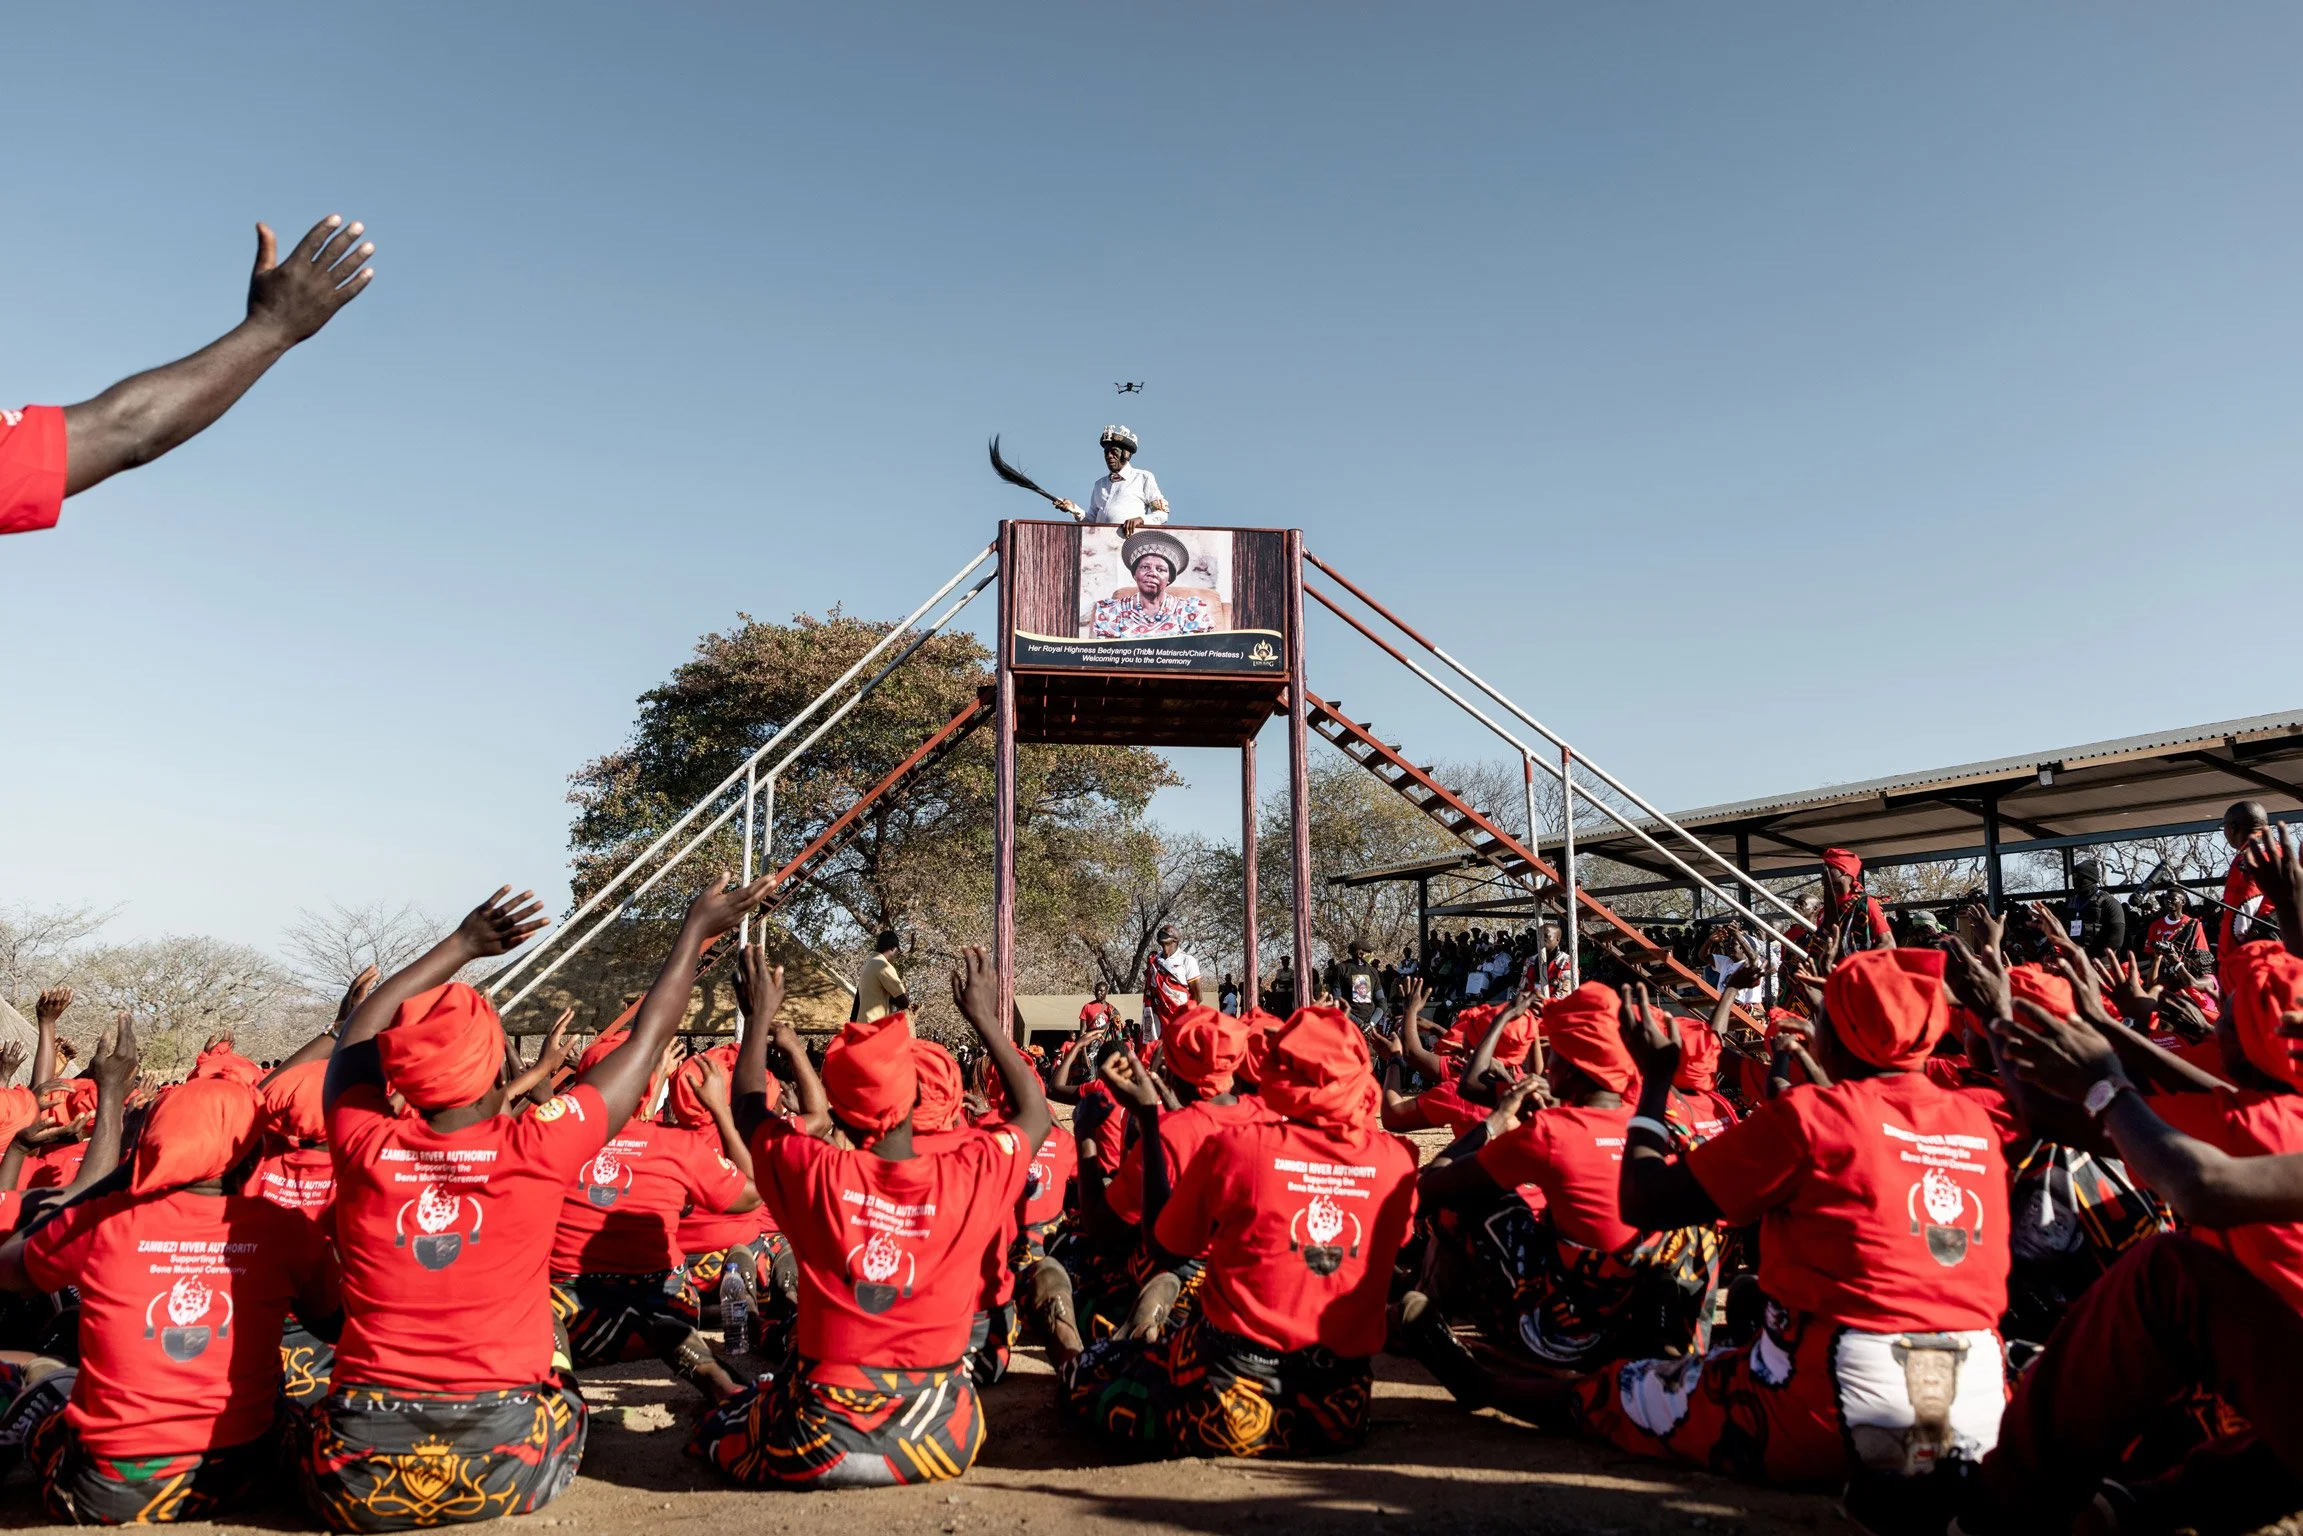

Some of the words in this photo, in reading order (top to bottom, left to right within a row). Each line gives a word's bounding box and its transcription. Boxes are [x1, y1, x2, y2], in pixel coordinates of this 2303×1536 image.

[1043, 645, 1062, 653] Royal
[1064, 646, 1096, 654] Highness
[1098, 647, 1131, 655] Bedyango
[1156, 648, 1207, 657] Matriarch/Chief
[1082, 655, 1120, 664] Welcoming
[1156, 657, 1191, 666] Ceremony
[381, 1148, 418, 1161] ZAMBEZI
[420, 1150, 444, 1161] RIVER
[447, 1150, 498, 1162] AUTHORITY
[414, 1162, 456, 1172] Supporting
[458, 1164, 471, 1172] the
[448, 1174, 489, 1183] Ceremony
[138, 1241, 177, 1253] ZAMBEZI
[180, 1242, 206, 1253] RIVER
[208, 1242, 258, 1253] AUTHORITY
[170, 1254, 216, 1264] Supporting
[150, 1264, 172, 1274] Bene
[173, 1265, 203, 1274] Mukuni
[205, 1265, 246, 1275] Ceremony
